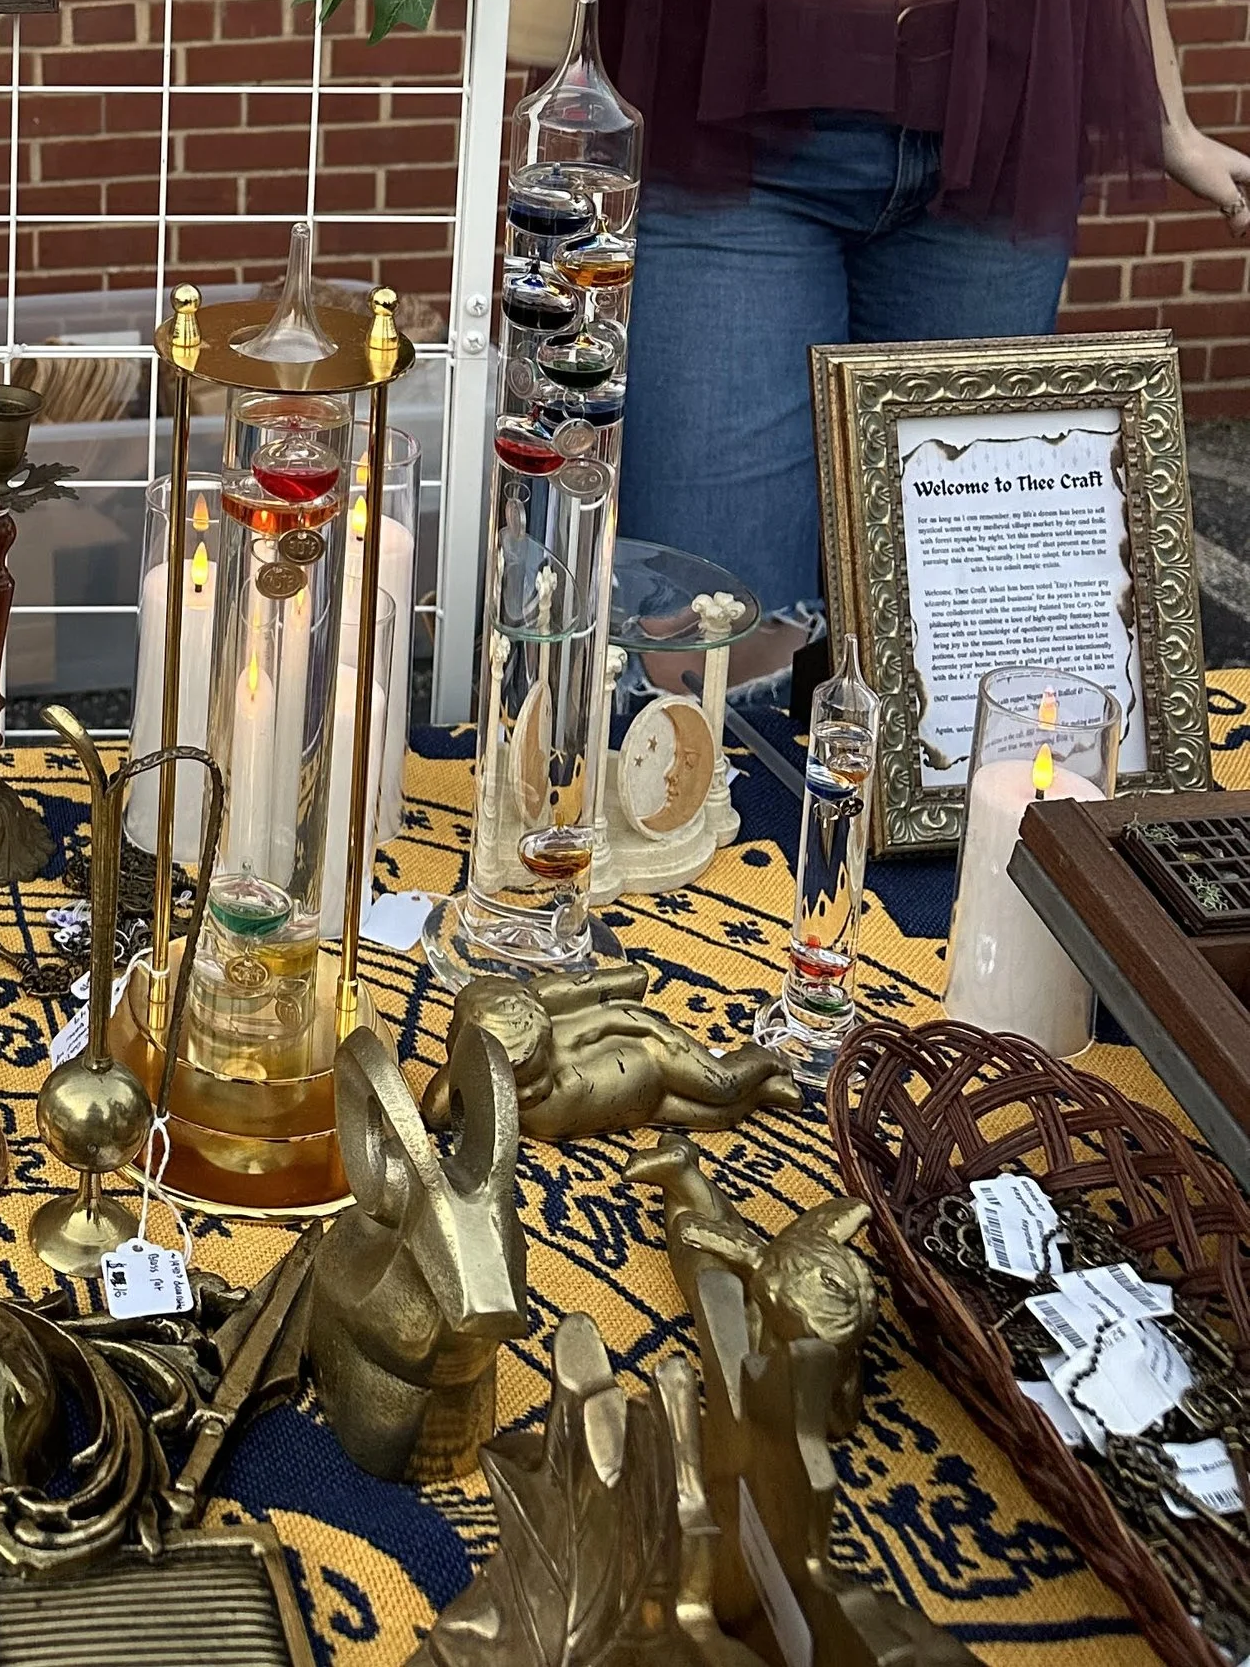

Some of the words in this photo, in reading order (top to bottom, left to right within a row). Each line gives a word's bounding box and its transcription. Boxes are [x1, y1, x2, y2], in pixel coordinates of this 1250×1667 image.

[913, 479, 989, 497] Welcome
[995, 477, 1012, 493] to
[1017, 474, 1055, 491] Thee
[1060, 470, 1103, 488] Craft
